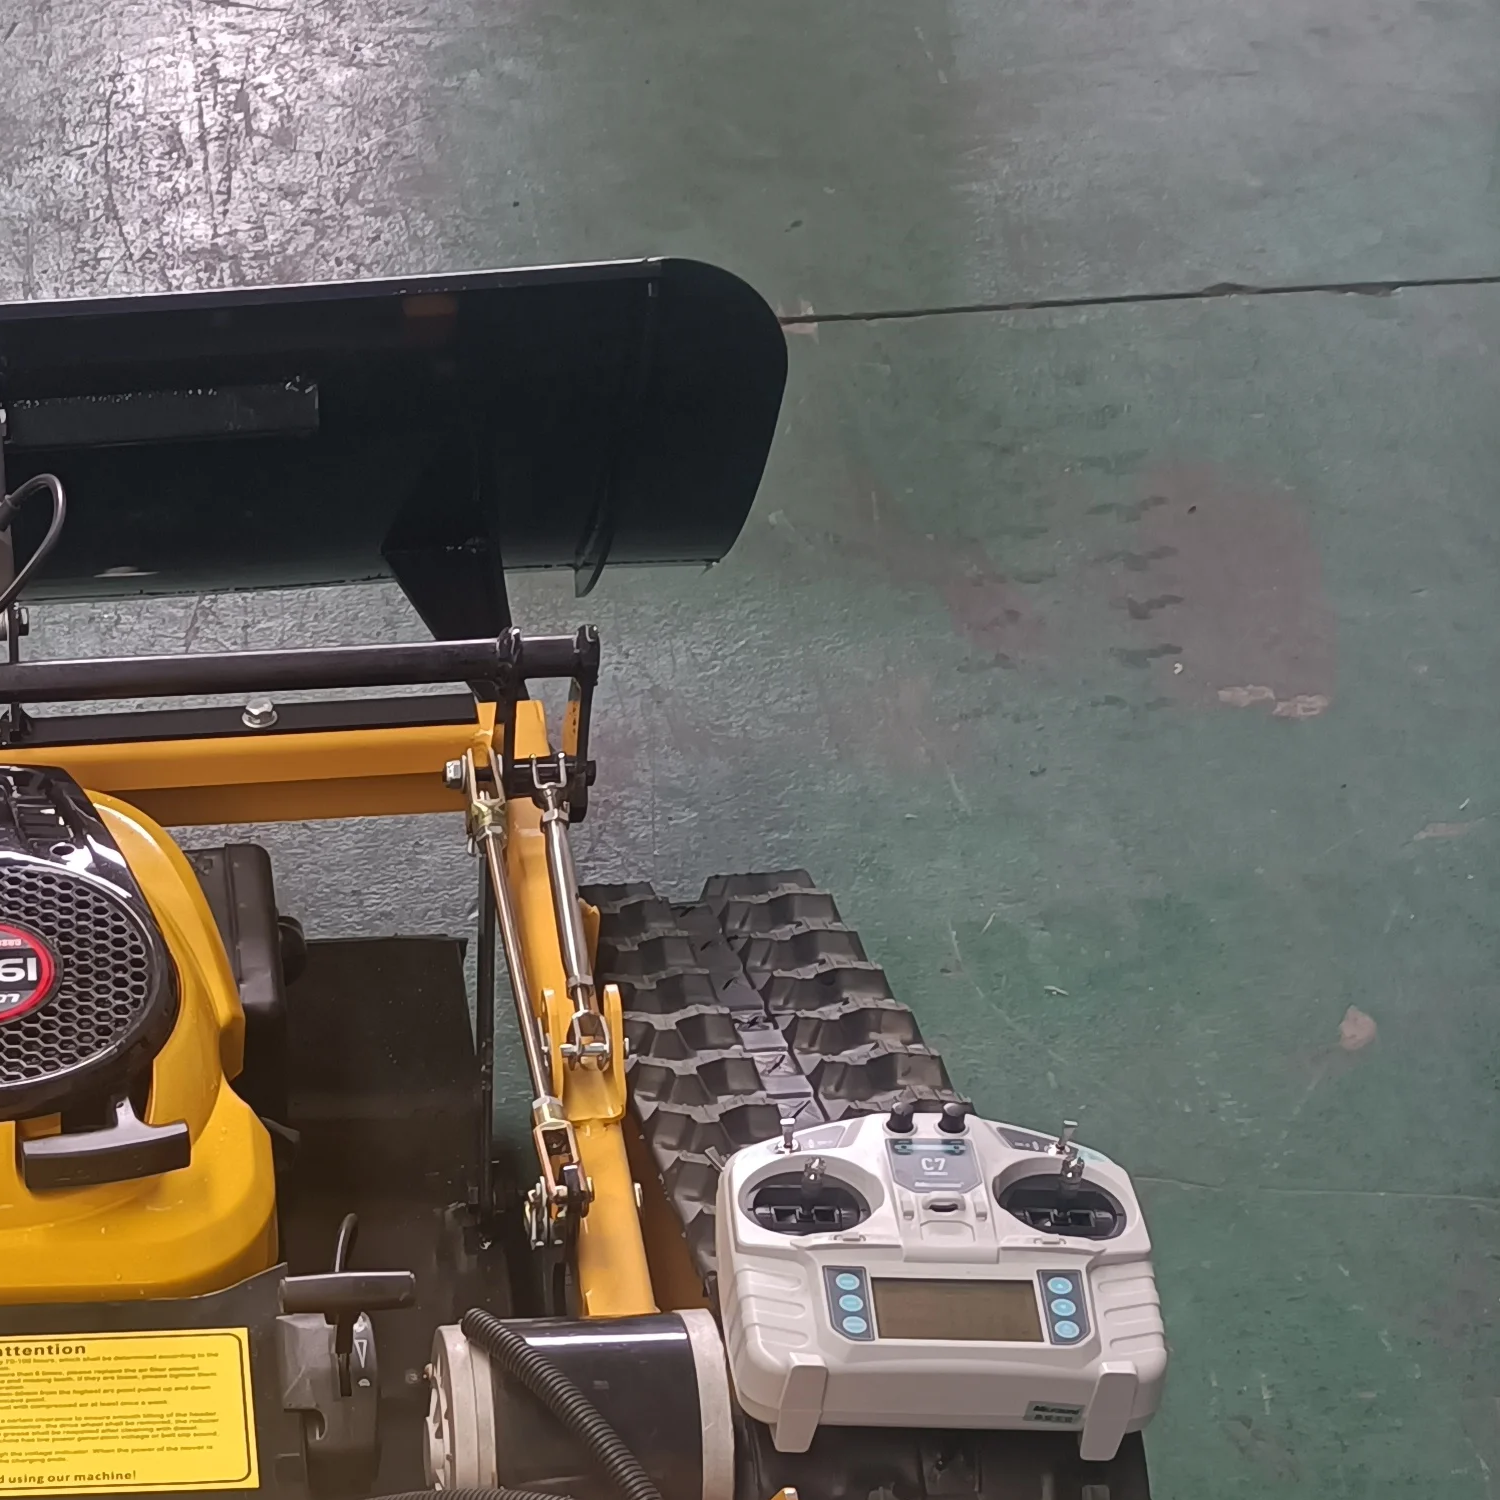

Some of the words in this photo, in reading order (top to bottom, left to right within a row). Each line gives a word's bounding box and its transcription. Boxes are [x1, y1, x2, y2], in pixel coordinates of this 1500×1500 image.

[921, 1157, 946, 1171] C7
[8, 1473, 44, 1486] using
[47, 1473, 71, 1483] our
[74, 1470, 136, 1482] machine!
